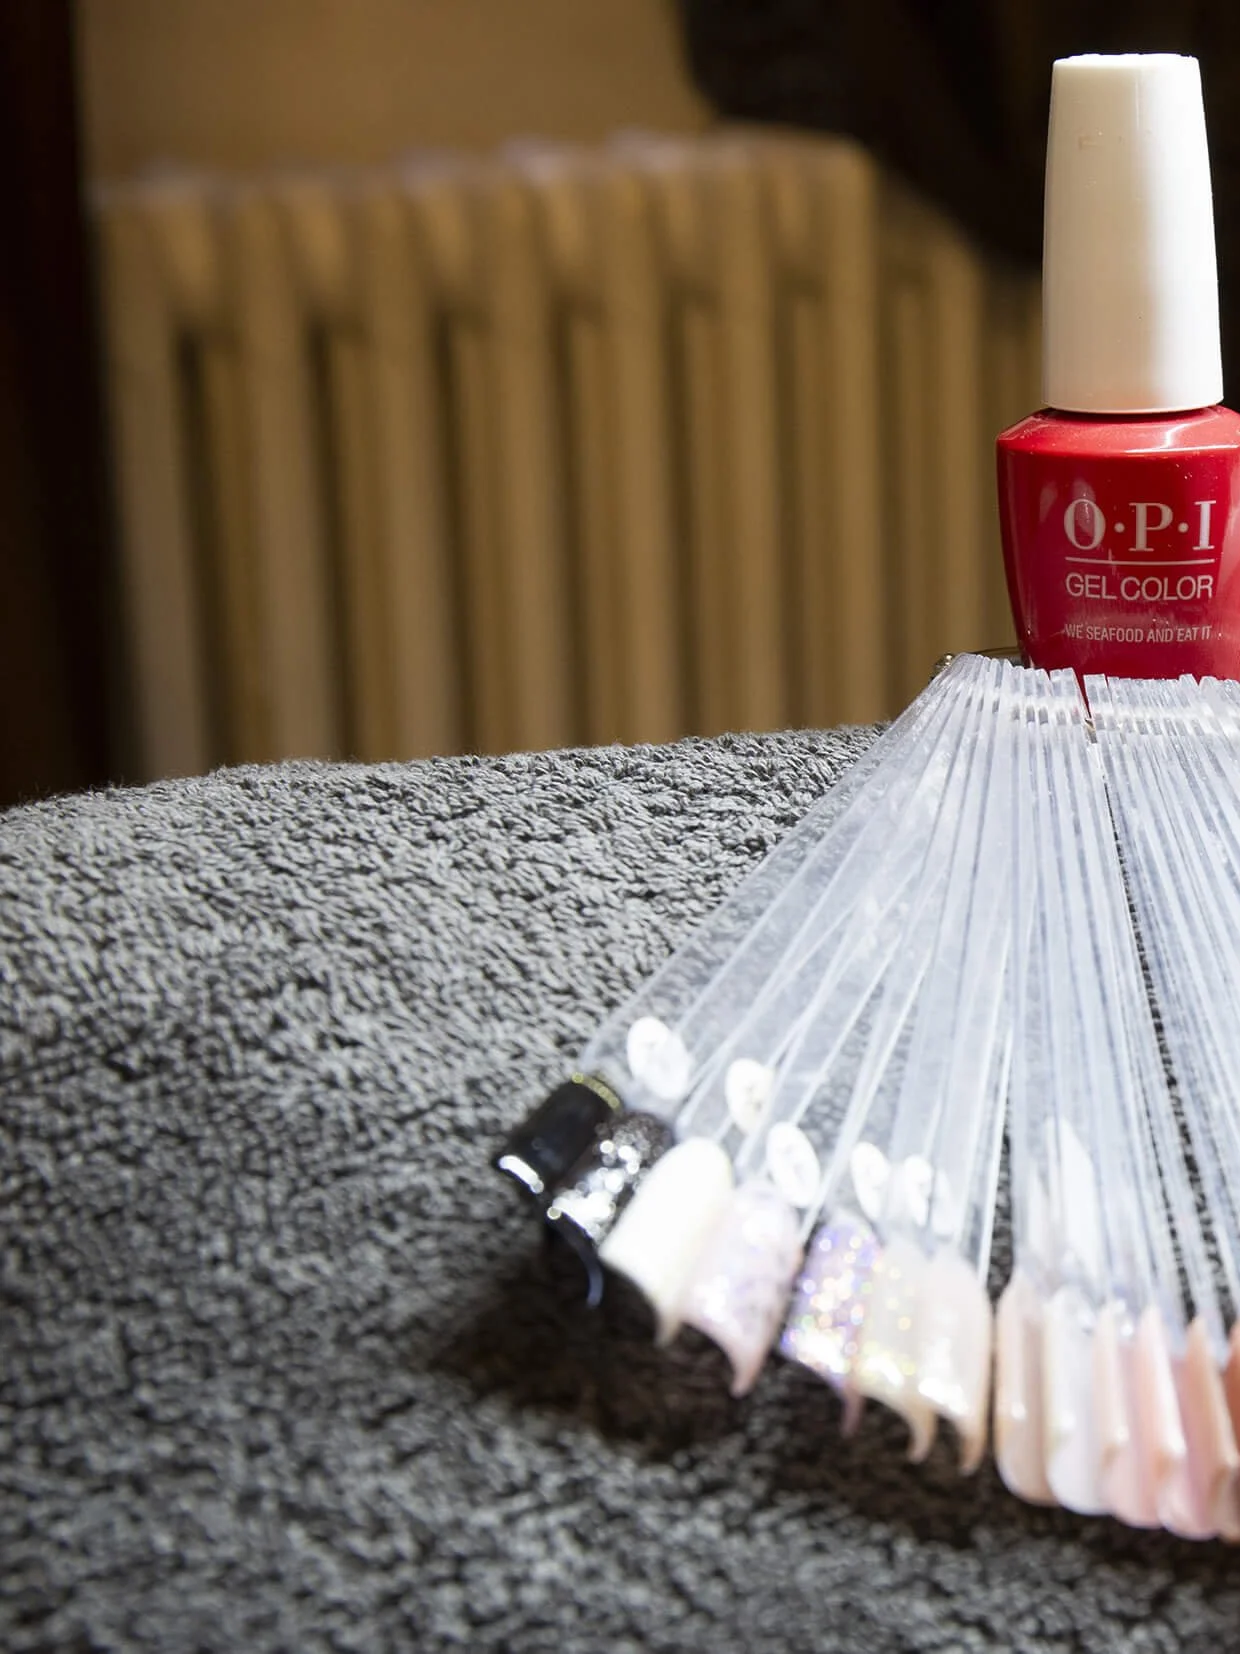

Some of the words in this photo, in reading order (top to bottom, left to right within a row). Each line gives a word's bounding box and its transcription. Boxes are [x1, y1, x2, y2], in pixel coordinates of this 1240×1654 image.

[1065, 572, 1117, 600] GEL
[1120, 574, 1214, 601] COLOR
[1065, 623, 1084, 640] WE
[1086, 625, 1144, 643] SEAFOOD
[1146, 628, 1174, 643] AND
[1176, 627, 1199, 642] EAT
[1201, 625, 1213, 640] IT
